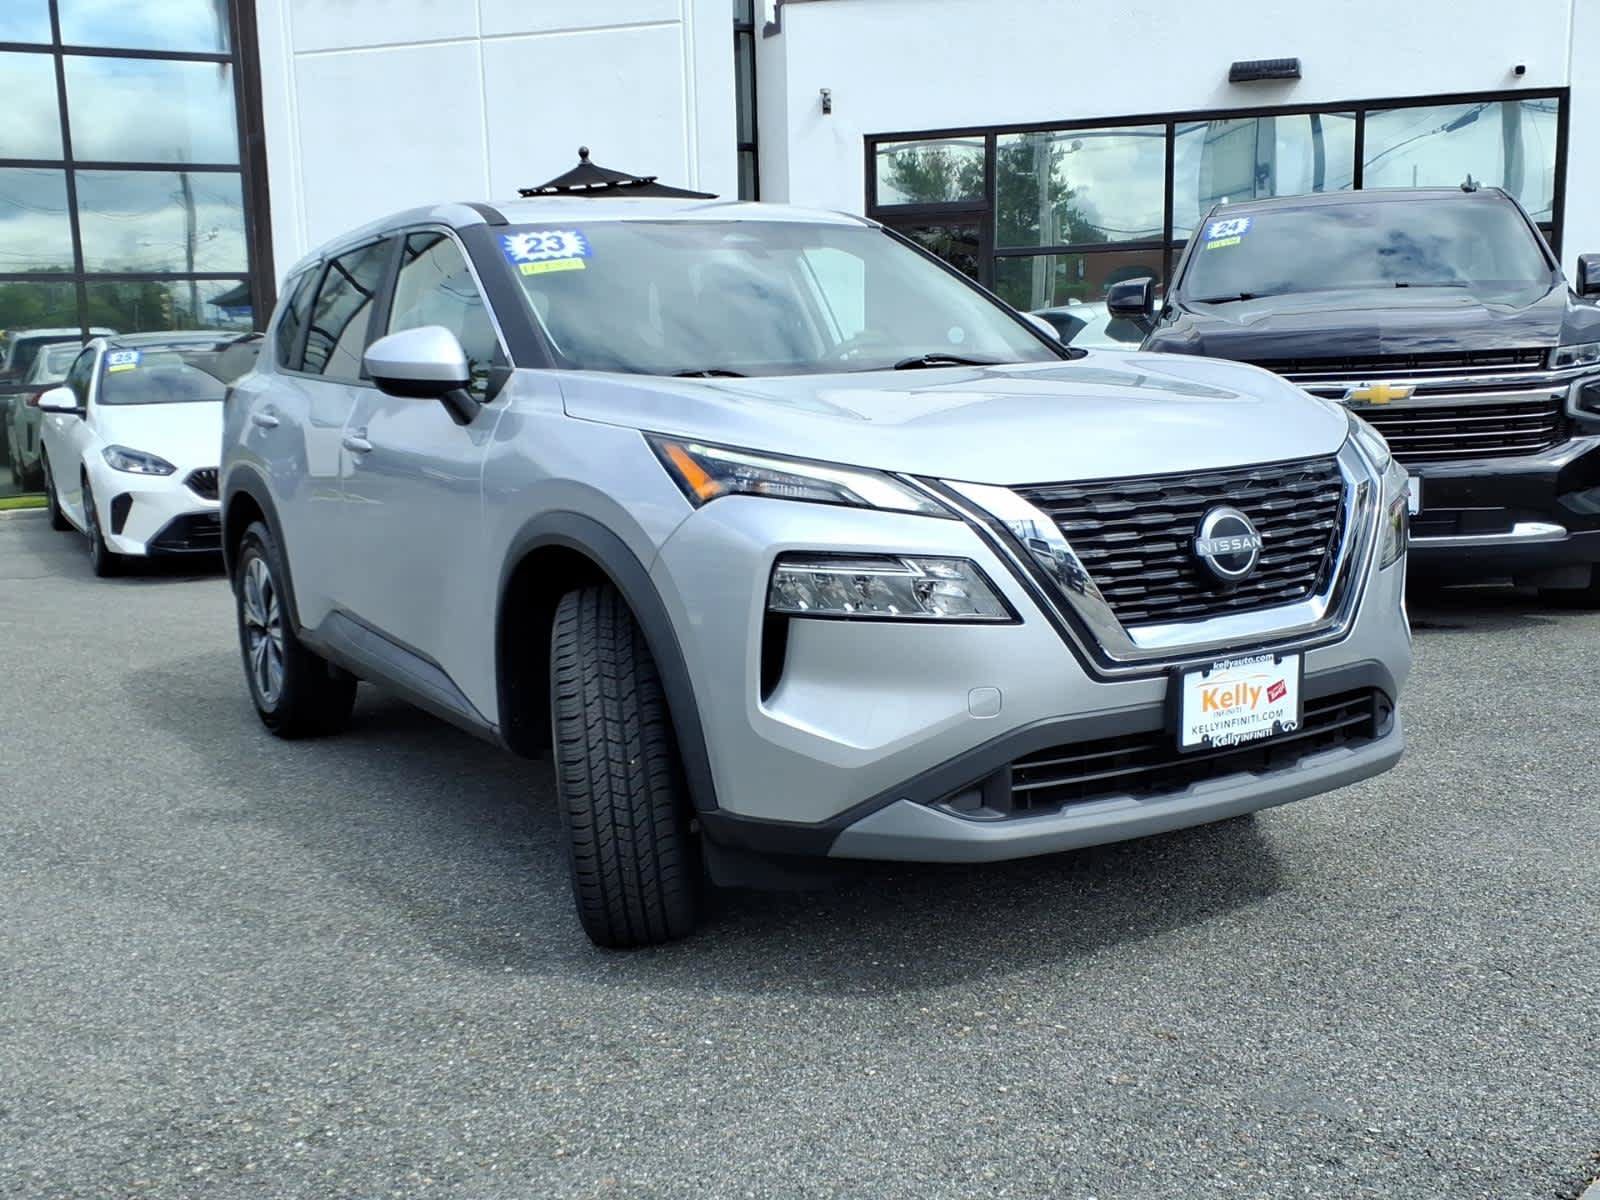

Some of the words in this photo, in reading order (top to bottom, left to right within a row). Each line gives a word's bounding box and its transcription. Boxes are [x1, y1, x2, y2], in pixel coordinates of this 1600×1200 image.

[1215, 220, 1240, 235] 24
[524, 235, 566, 254] 23
[1199, 535, 1261, 553] NISSAN
[1212, 653, 1274, 670] kellyauto.com
[1202, 682, 1263, 713] Kelly
[1191, 708, 1284, 735] KELLYINFINITI.COM
